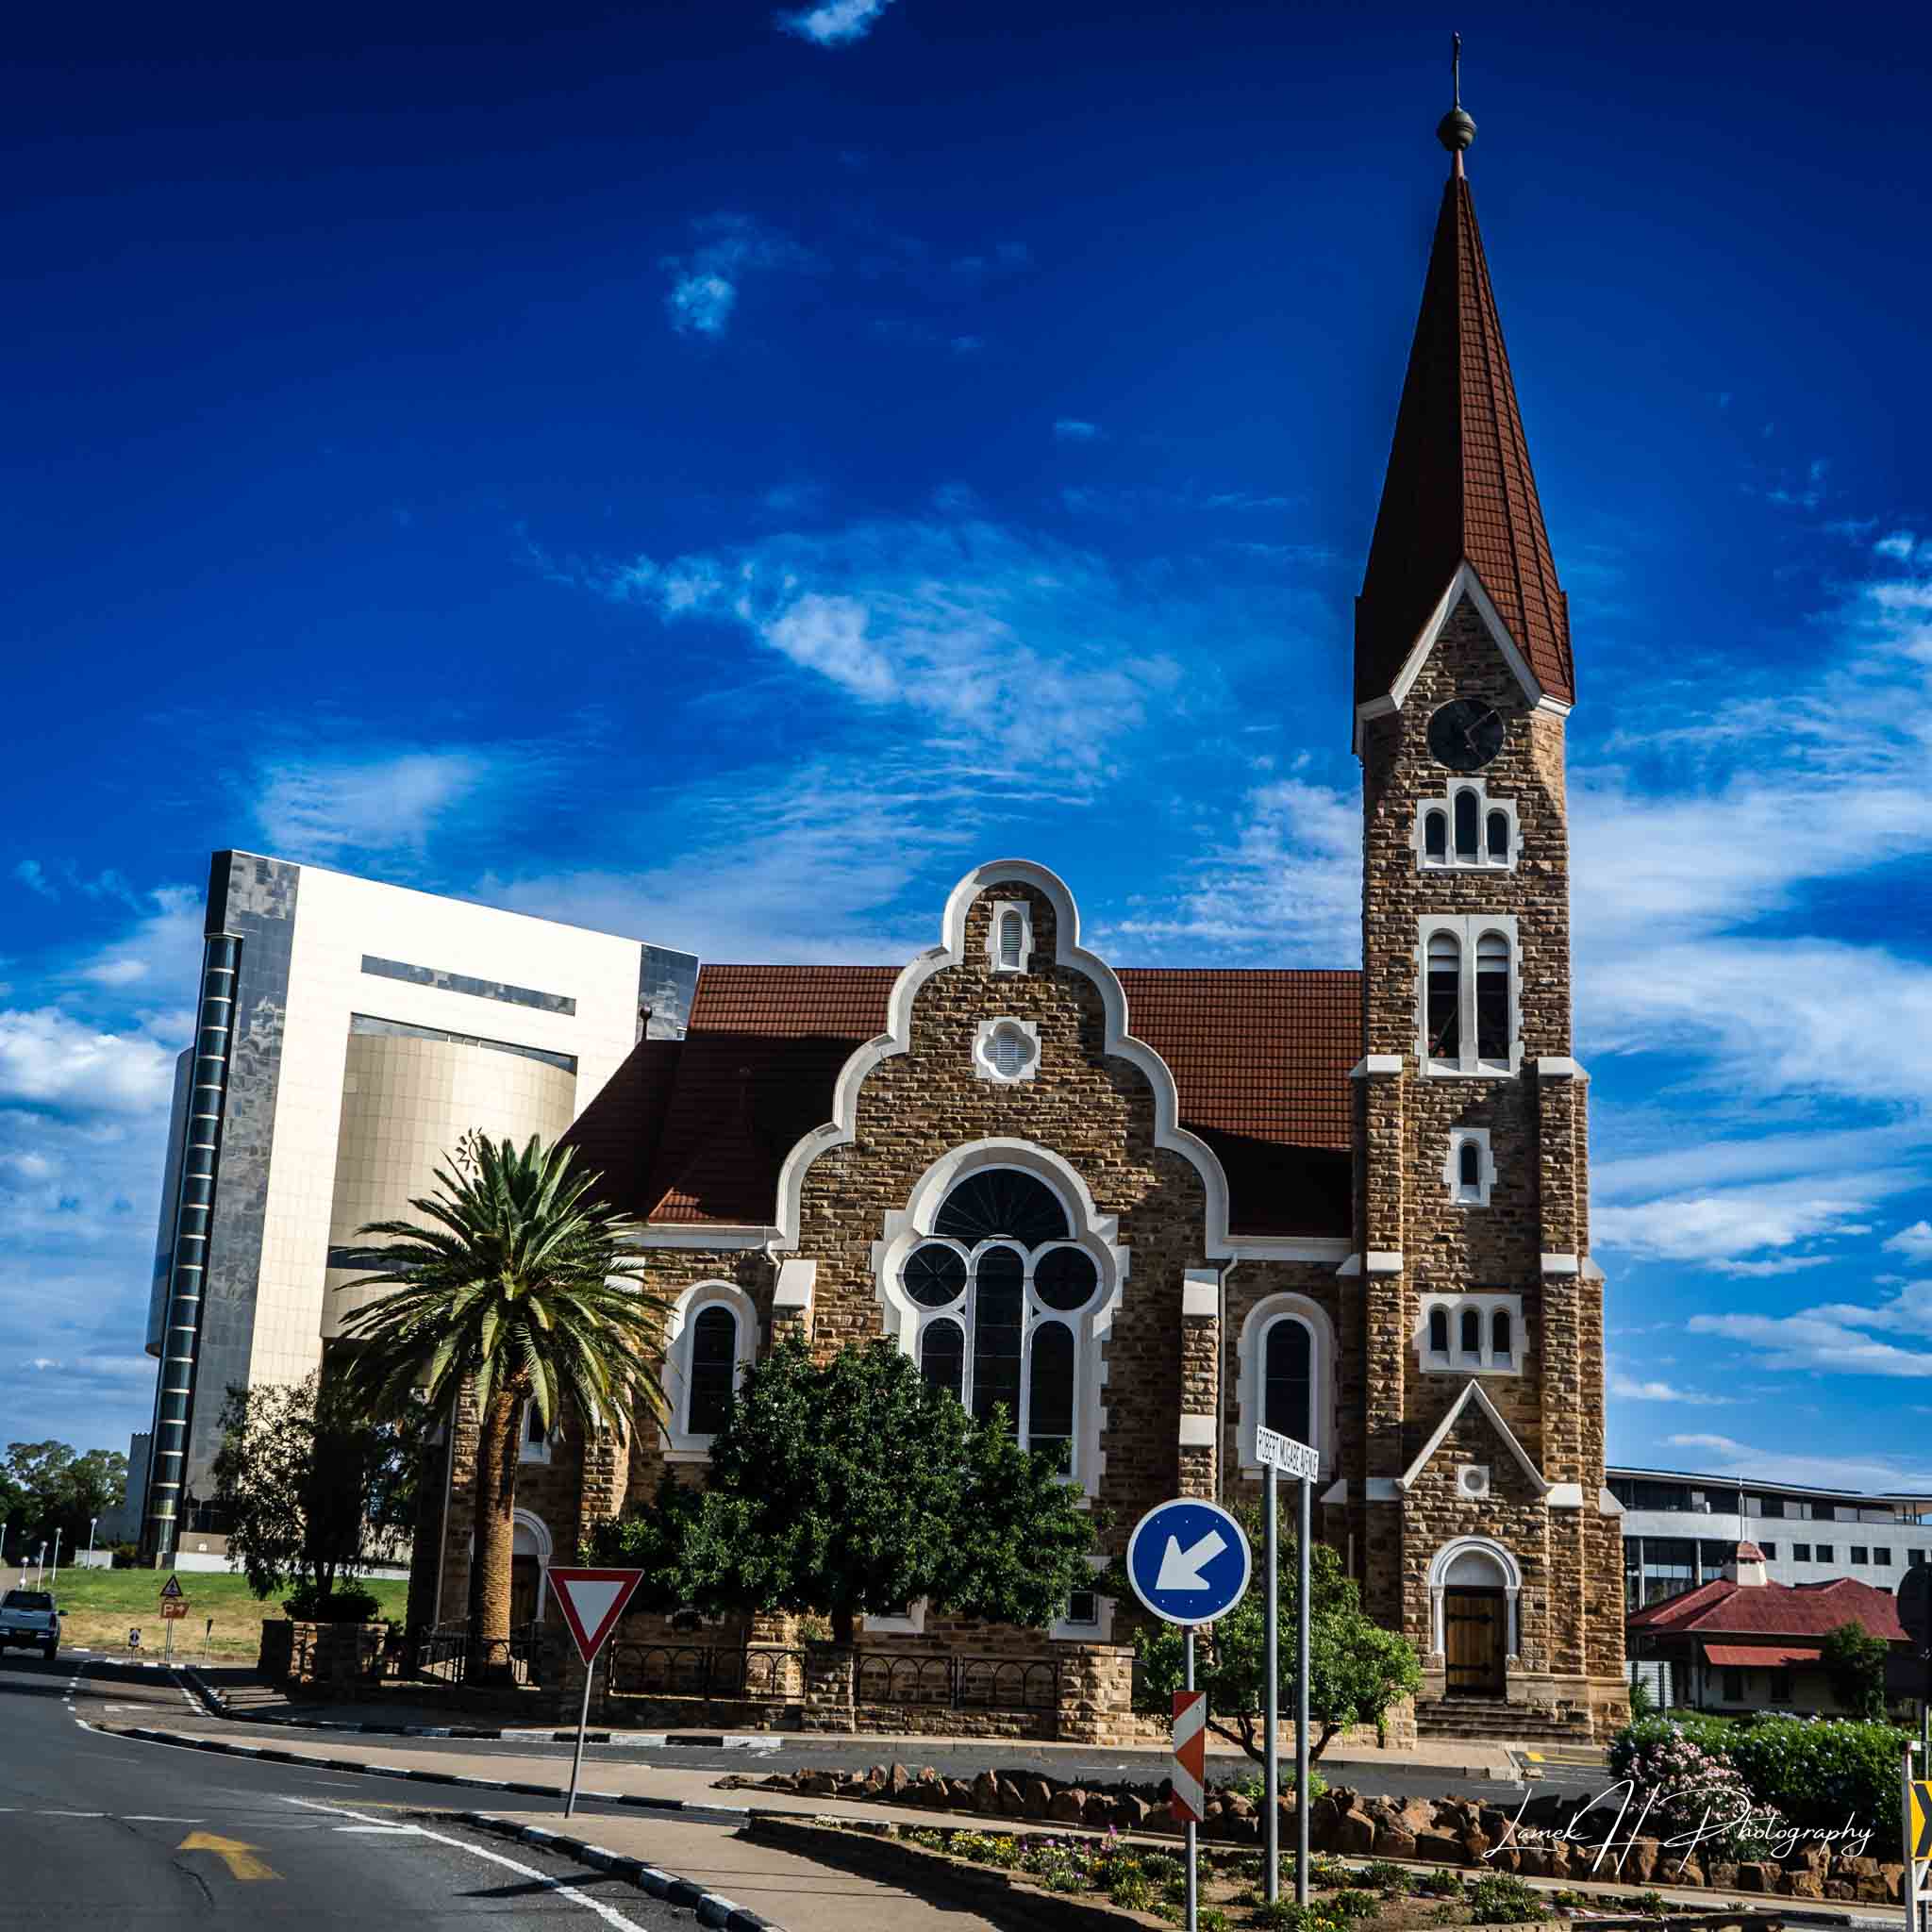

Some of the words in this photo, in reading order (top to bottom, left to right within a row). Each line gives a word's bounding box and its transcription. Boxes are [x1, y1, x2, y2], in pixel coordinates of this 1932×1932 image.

[1257, 1428, 1279, 1463] ROBERT
[1280, 1438, 1300, 1472] MUGABE
[163, 1604, 175, 1616] P
